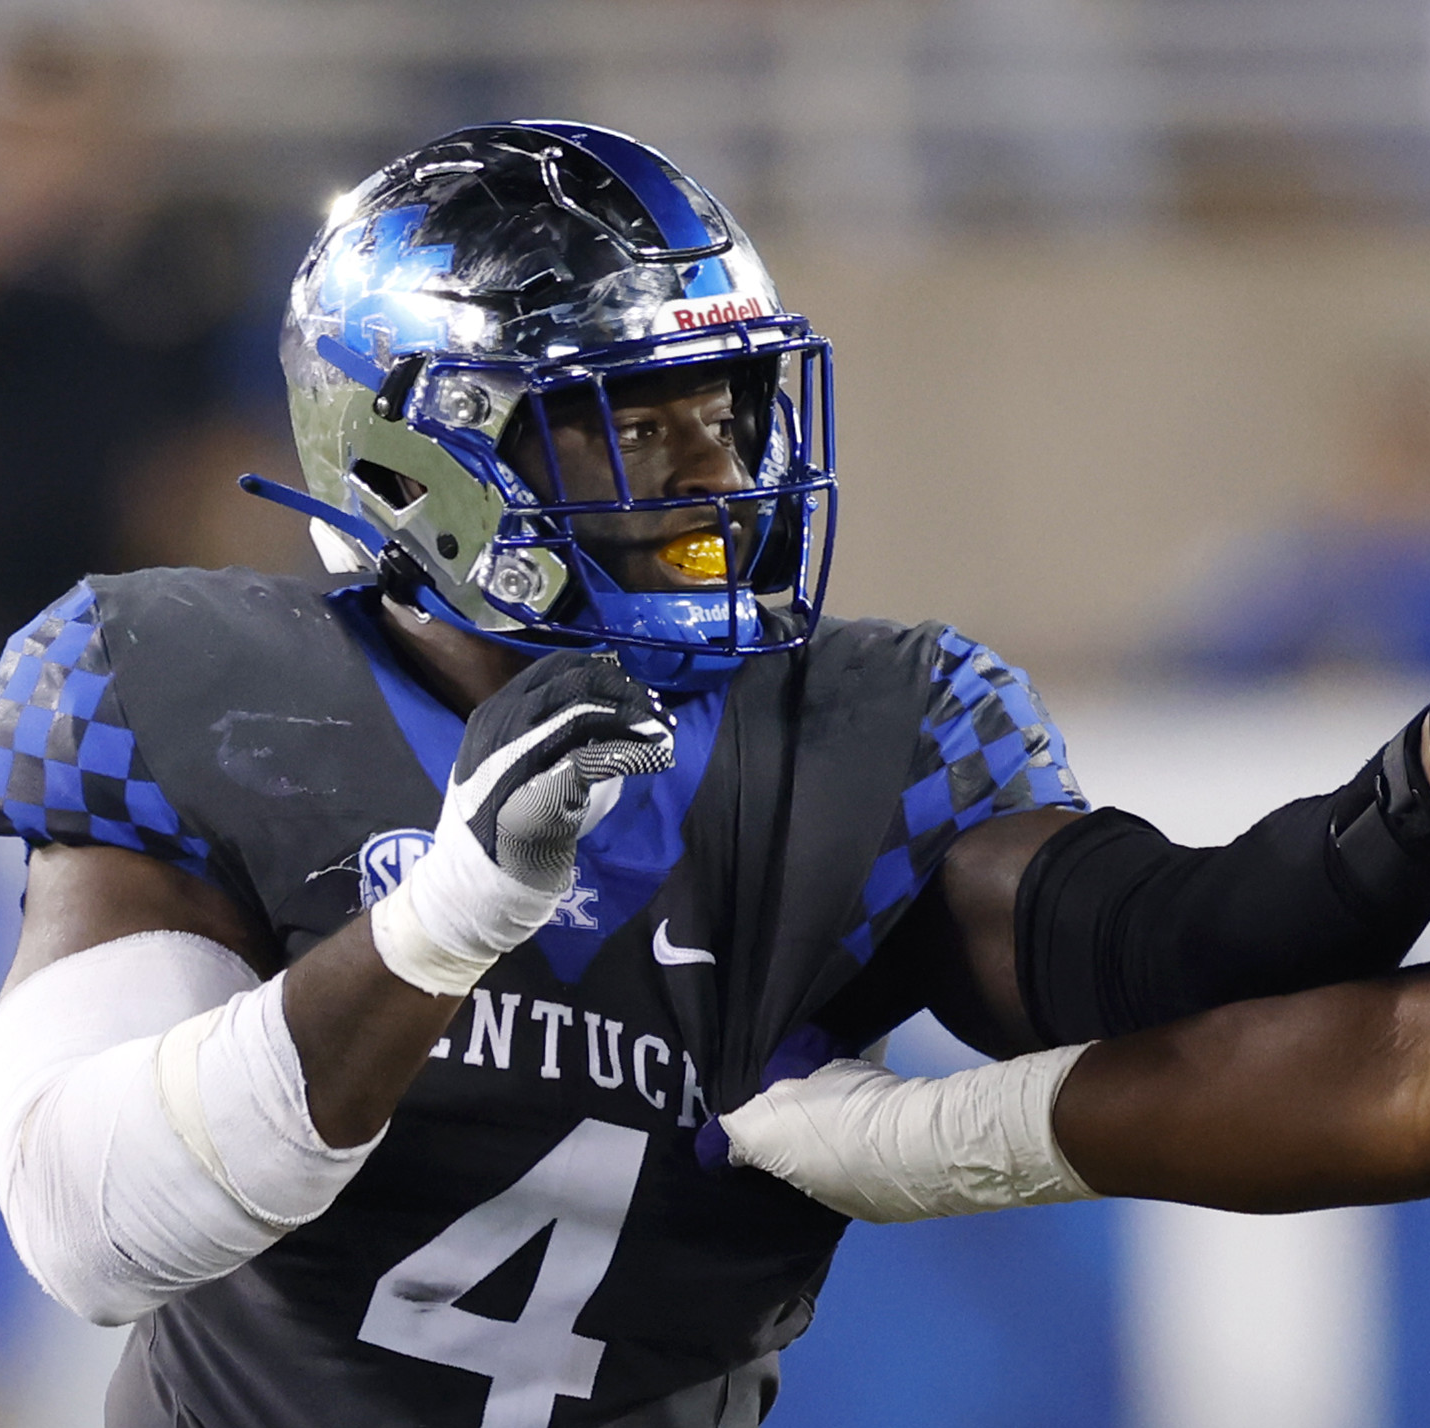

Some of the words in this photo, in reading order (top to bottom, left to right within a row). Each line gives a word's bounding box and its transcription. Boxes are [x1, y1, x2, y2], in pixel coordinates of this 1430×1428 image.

[673, 297, 763, 330] Riddell
[757, 429, 787, 516] Rddell
[688, 601, 730, 622] Ridd
